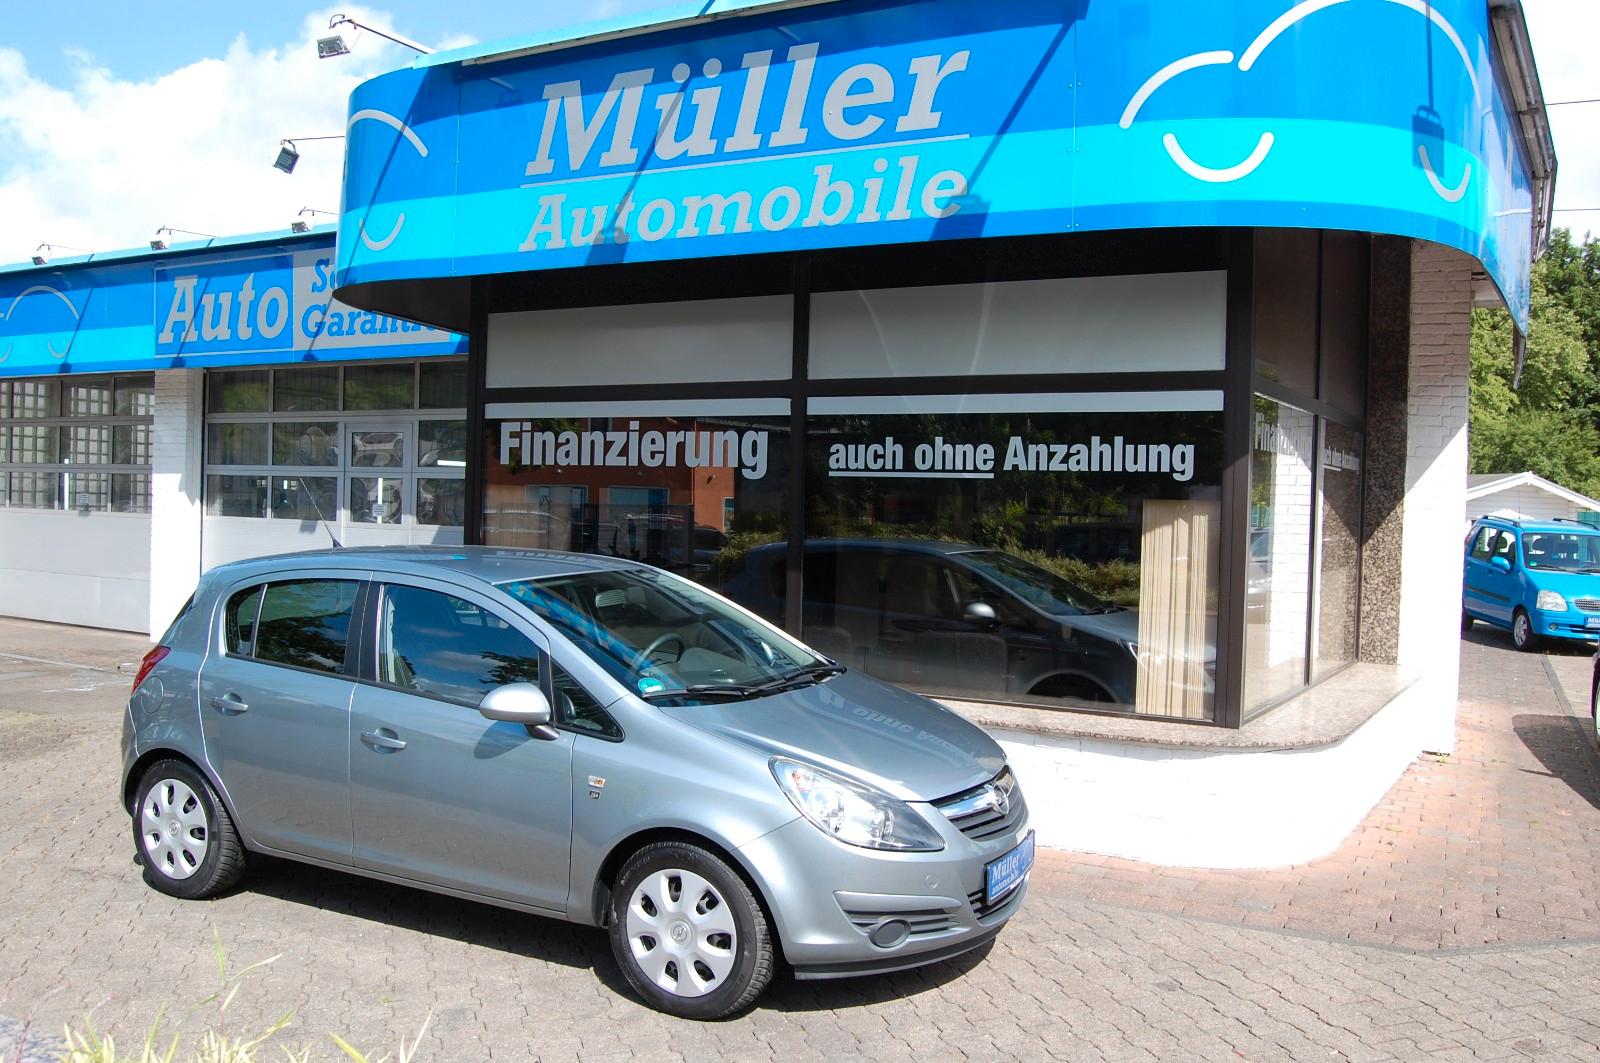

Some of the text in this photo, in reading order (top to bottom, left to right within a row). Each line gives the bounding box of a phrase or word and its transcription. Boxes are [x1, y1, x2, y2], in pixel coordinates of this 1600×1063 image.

[525, 42, 970, 176] Müller
[518, 156, 968, 252] Automobile
[158, 273, 290, 344] Auto
[500, 420, 769, 480] Finanzierung
[828, 435, 1195, 482] auch ohne Anzahlung
